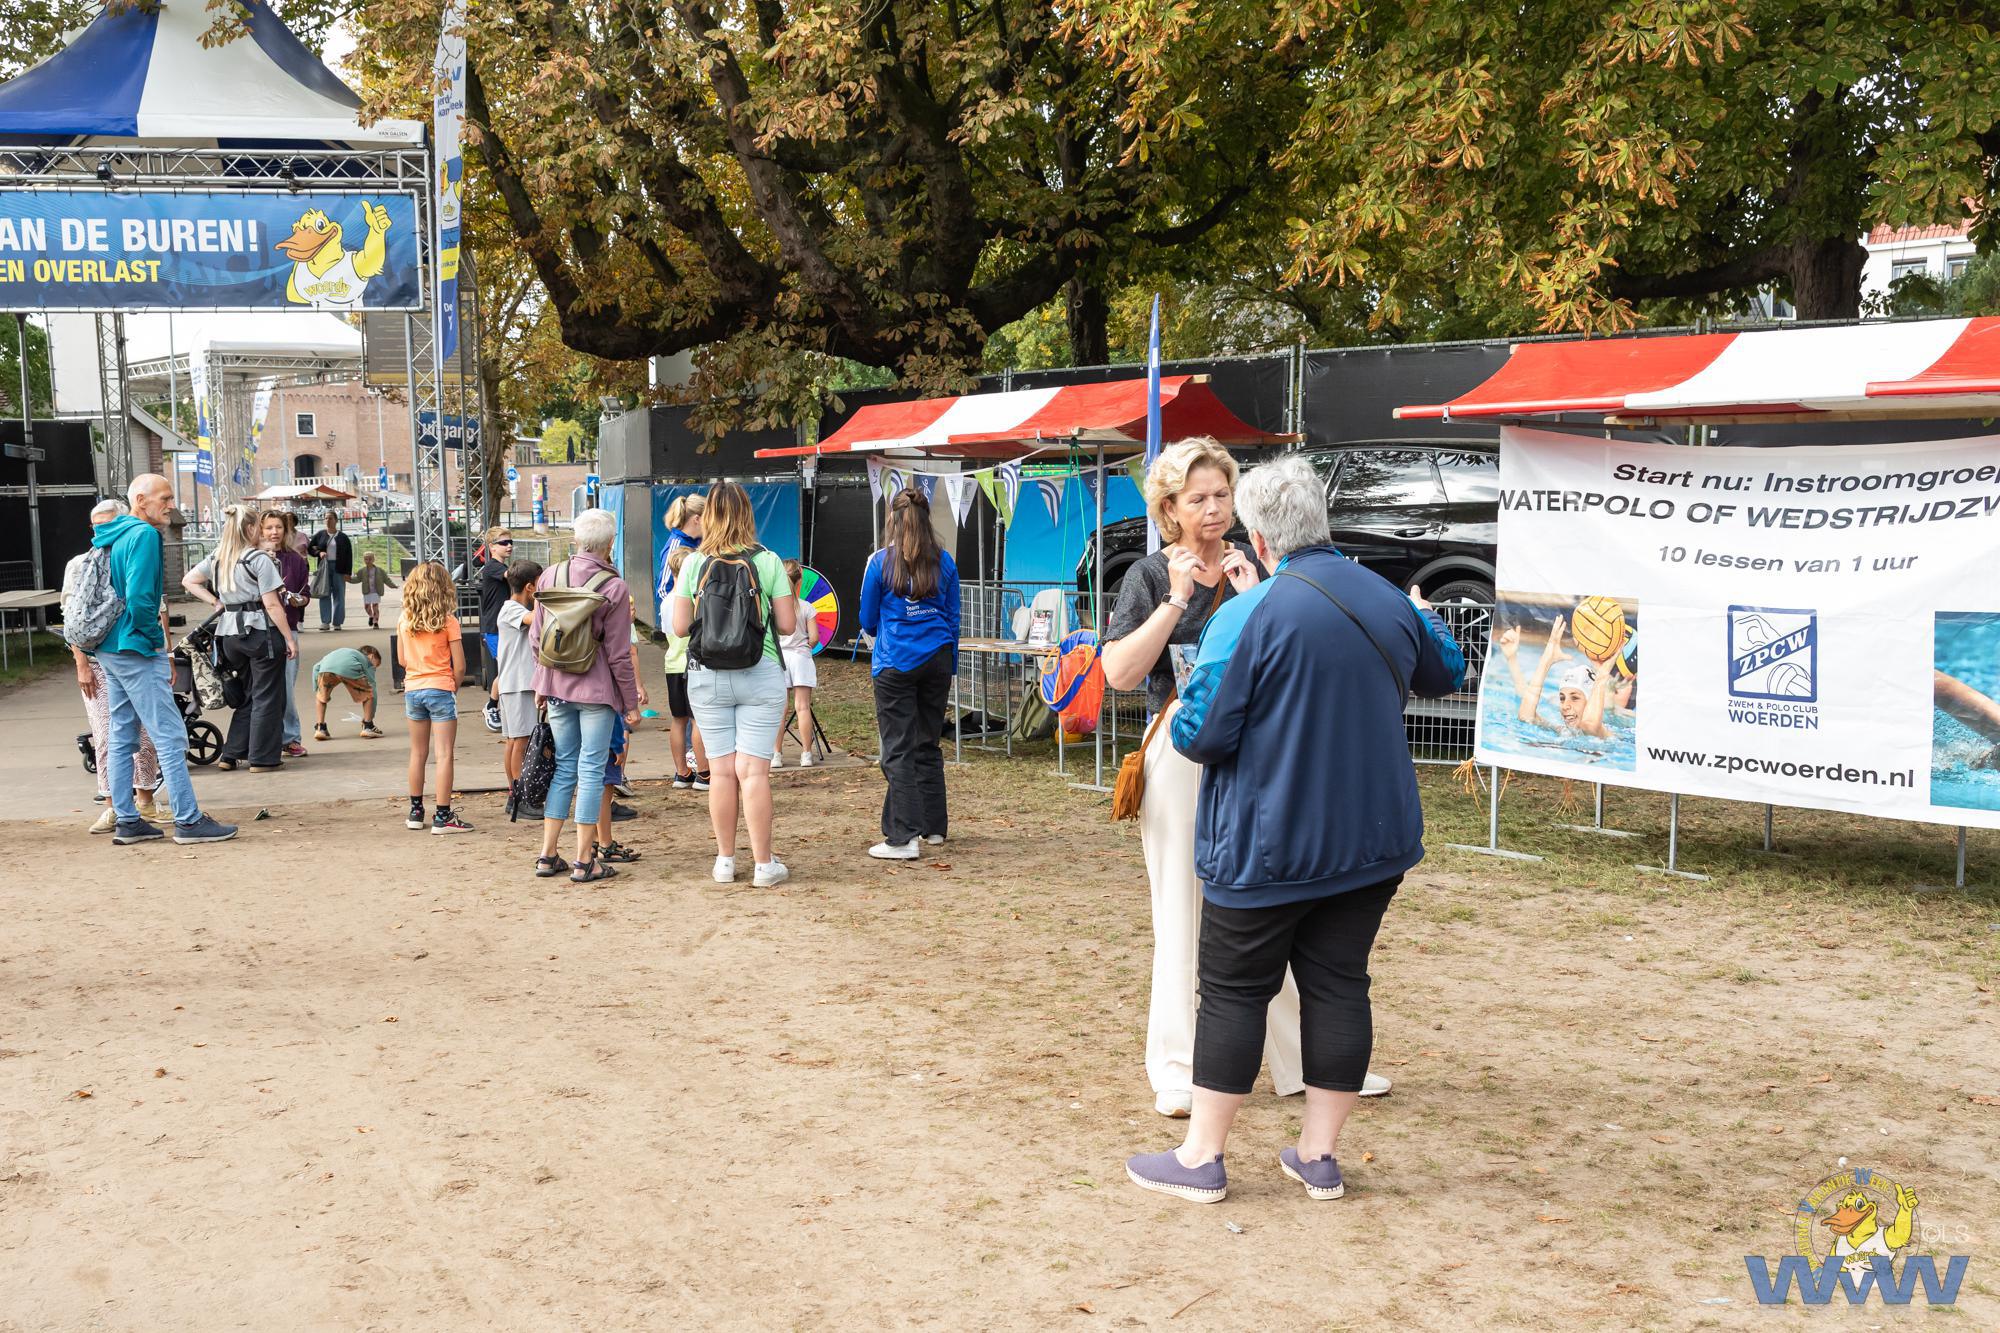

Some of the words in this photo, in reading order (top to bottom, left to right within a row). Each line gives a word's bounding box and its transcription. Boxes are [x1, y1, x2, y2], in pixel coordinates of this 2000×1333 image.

[60, 218, 109, 252] DE
[122, 218, 258, 252] BUREN!
[34, 259, 161, 283] OVERLAST
[1613, 463, 1694, 488] Start
[1701, 474, 1753, 492] nu:
[1764, 465, 2000, 493] Instroomgroe
[1498, 489, 1675, 520] WATERPOLO
[1687, 502, 1737, 525] OF
[1659, 545, 1687, 563] 10
[1694, 549, 1784, 572] lessen
[1794, 558, 1841, 573] van
[1852, 555, 1863, 572] 1
[1872, 555, 1919, 571] uur
[906, 604, 920, 612] Team
[1739, 628, 1809, 676] ZPCW
[1728, 699, 1754, 709] ZWEM
[1757, 702, 1764, 710] &
[1766, 702, 1791, 712] POLO
[1792, 705, 1818, 714] CLUB
[1728, 708, 1819, 730] WOERDEN
[1647, 746, 1914, 788] www.zpcwoerden.nl
